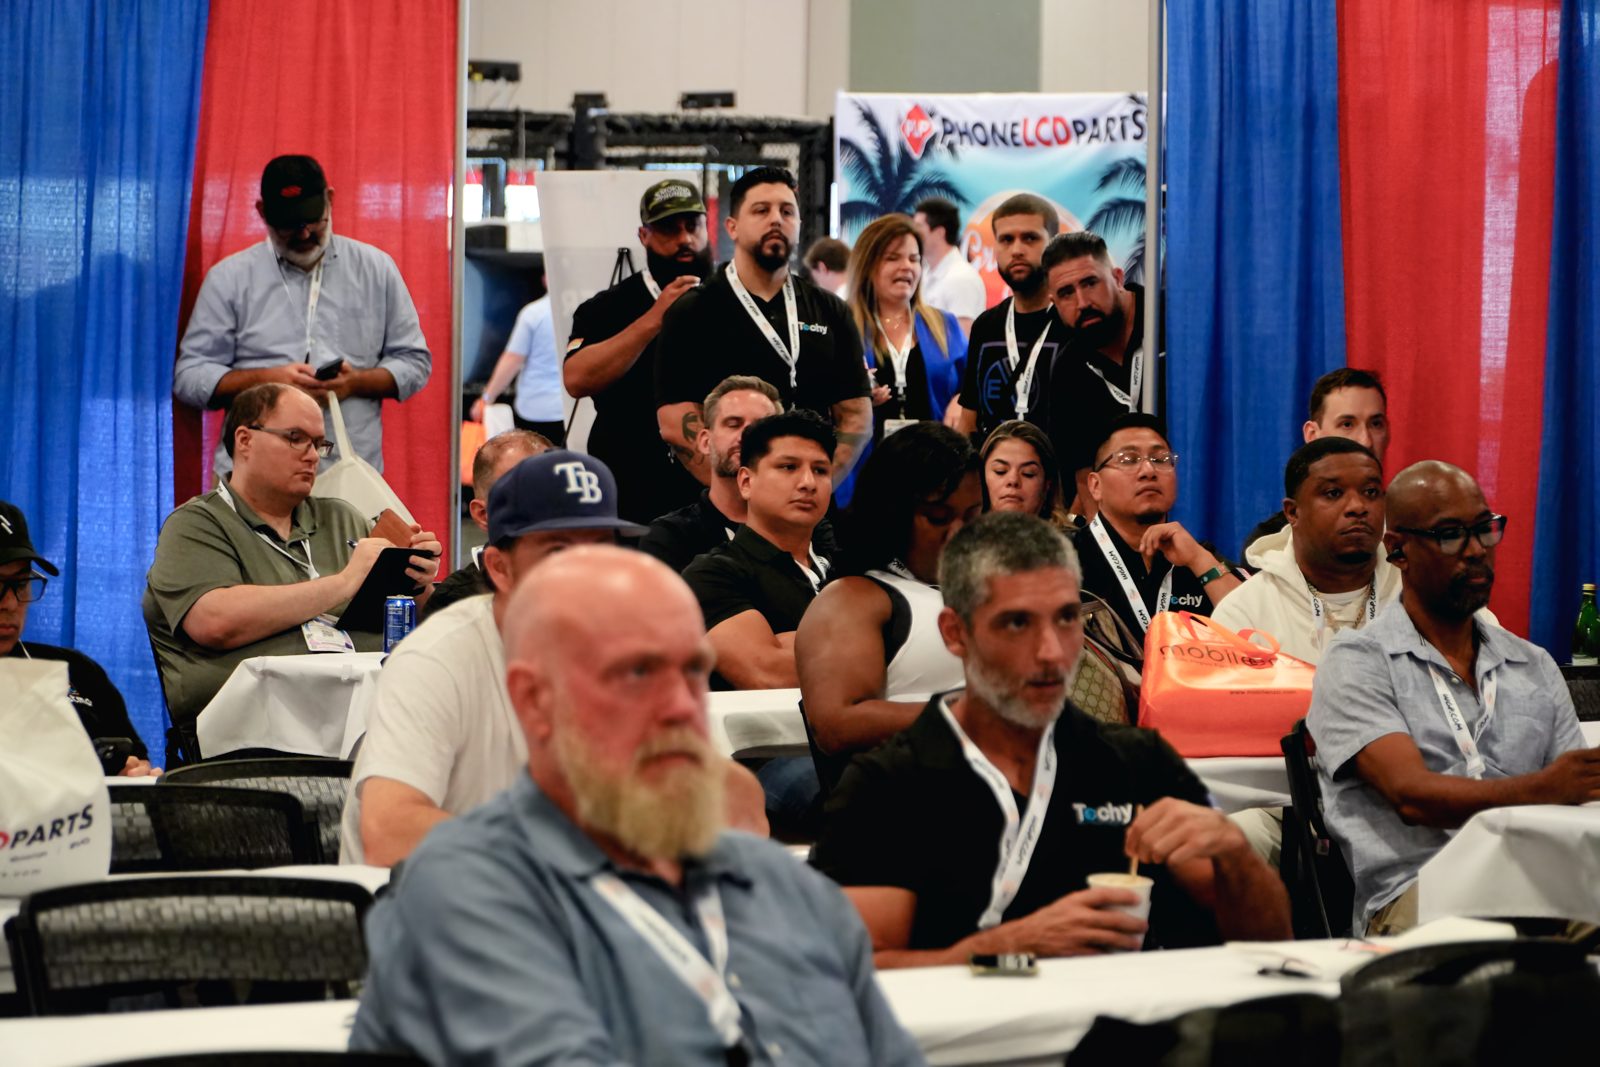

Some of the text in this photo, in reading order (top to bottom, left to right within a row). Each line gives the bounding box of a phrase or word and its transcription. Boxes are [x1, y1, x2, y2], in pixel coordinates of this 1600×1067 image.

[940, 109, 1145, 147] PHONELCDPARTS
[553, 461, 603, 504] TB
[1108, 550, 1128, 580] WGP.COM
[1169, 593, 1203, 607] echy
[1443, 693, 1463, 731] WGP.COM
[1072, 802, 1133, 824] Techy
